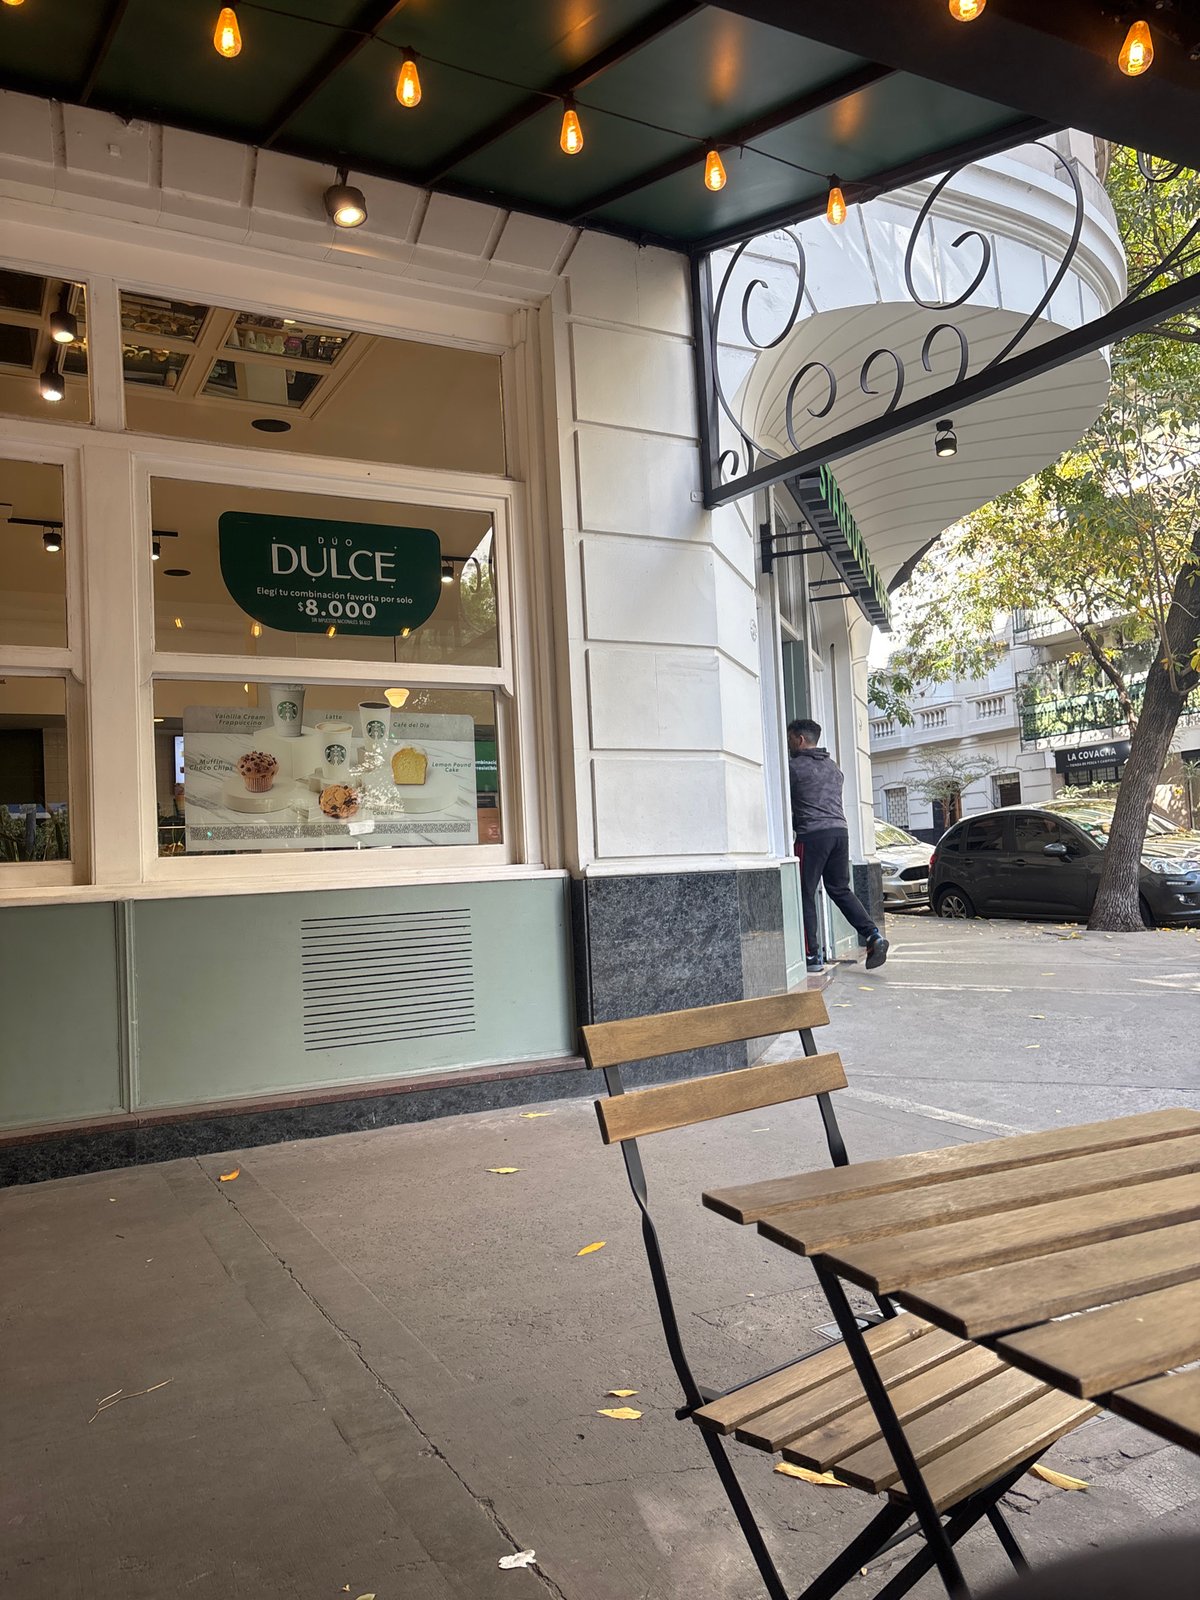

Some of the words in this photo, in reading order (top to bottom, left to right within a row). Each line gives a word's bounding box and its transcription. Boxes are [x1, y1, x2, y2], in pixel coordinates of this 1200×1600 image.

[318, 536, 353, 547] DÚO
[271, 543, 397, 583] DULCE
[256, 586, 278, 597] Elegí
[279, 588, 288, 597] tu
[290, 590, 345, 600] combinación
[346, 592, 379, 602] favorita
[381, 596, 395, 605] por
[397, 596, 413, 604] solo
[297, 599, 377, 619] $8.000
[1067, 753, 1077, 761] LA
[213, 764, 233, 772] Chips
